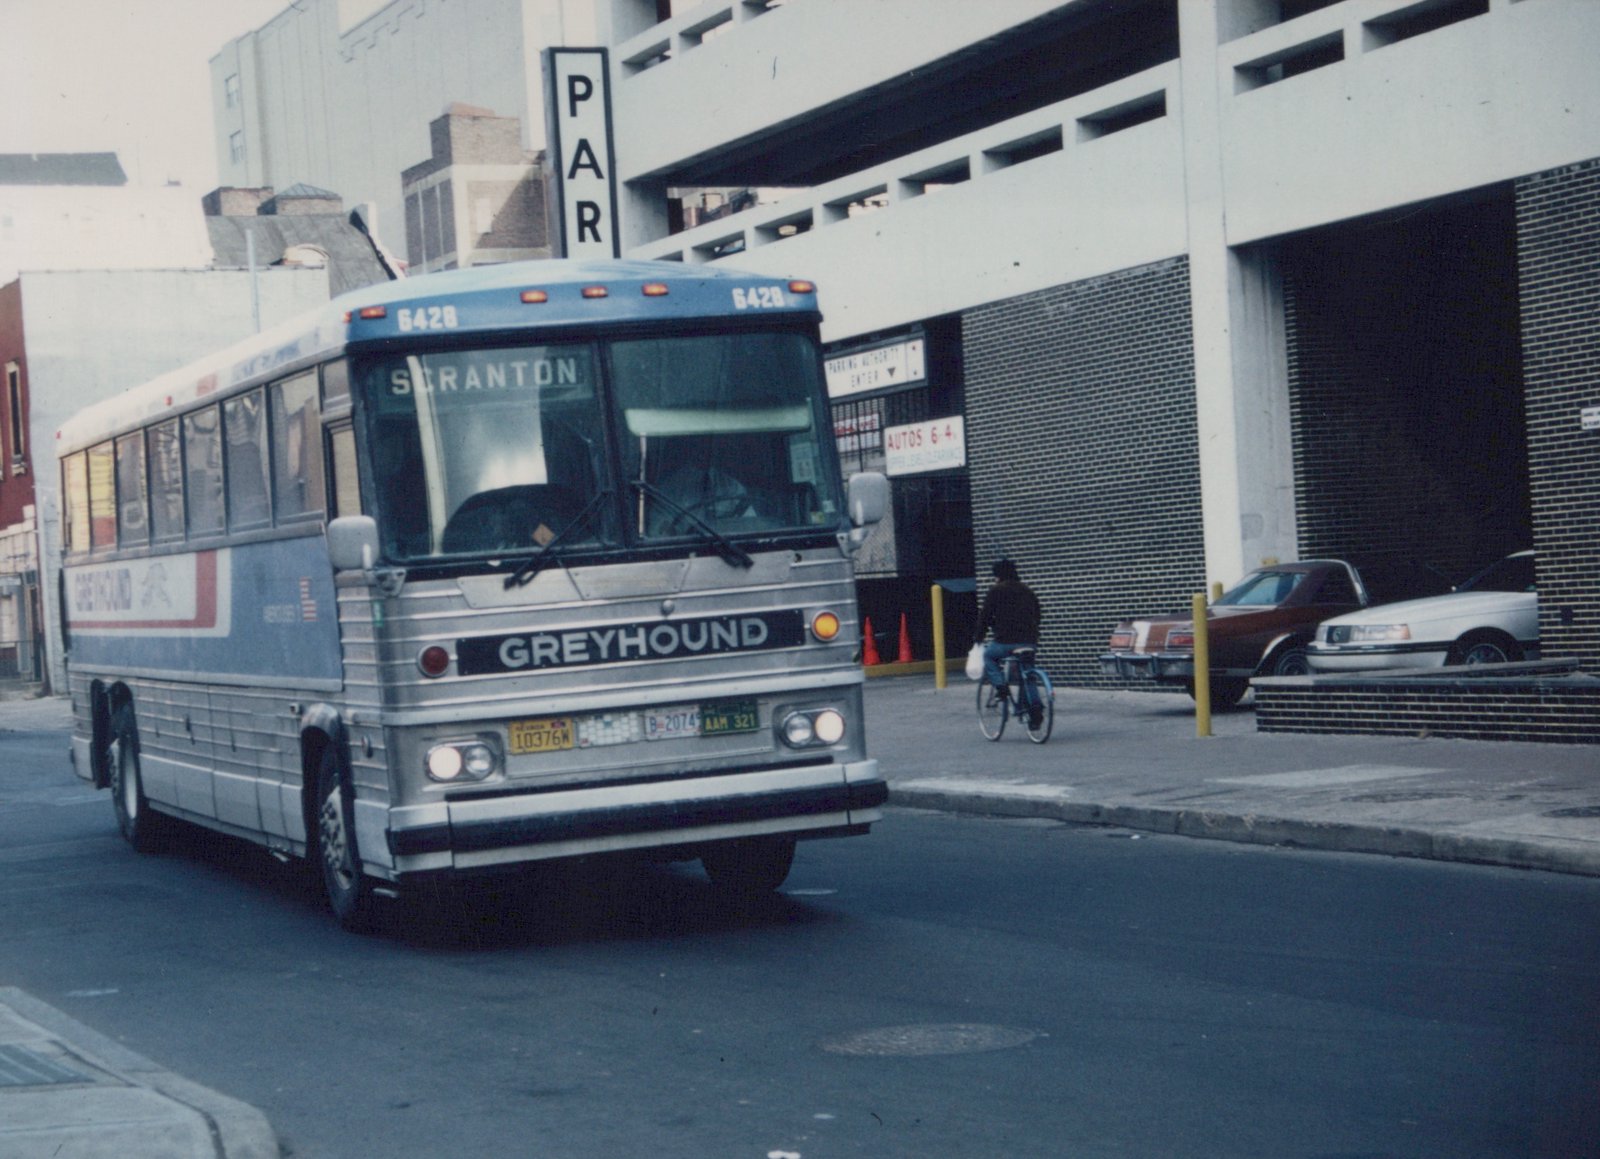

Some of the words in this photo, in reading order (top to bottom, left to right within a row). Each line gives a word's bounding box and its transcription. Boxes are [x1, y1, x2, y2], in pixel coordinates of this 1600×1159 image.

[567, 75, 605, 243] PAR
[391, 358, 577, 395] SCRANTON
[887, 428, 923, 450] AUTOS
[499, 618, 768, 669] GREYHOUND
[734, 713, 755, 729] 321
[516, 728, 570, 749] 10376W
